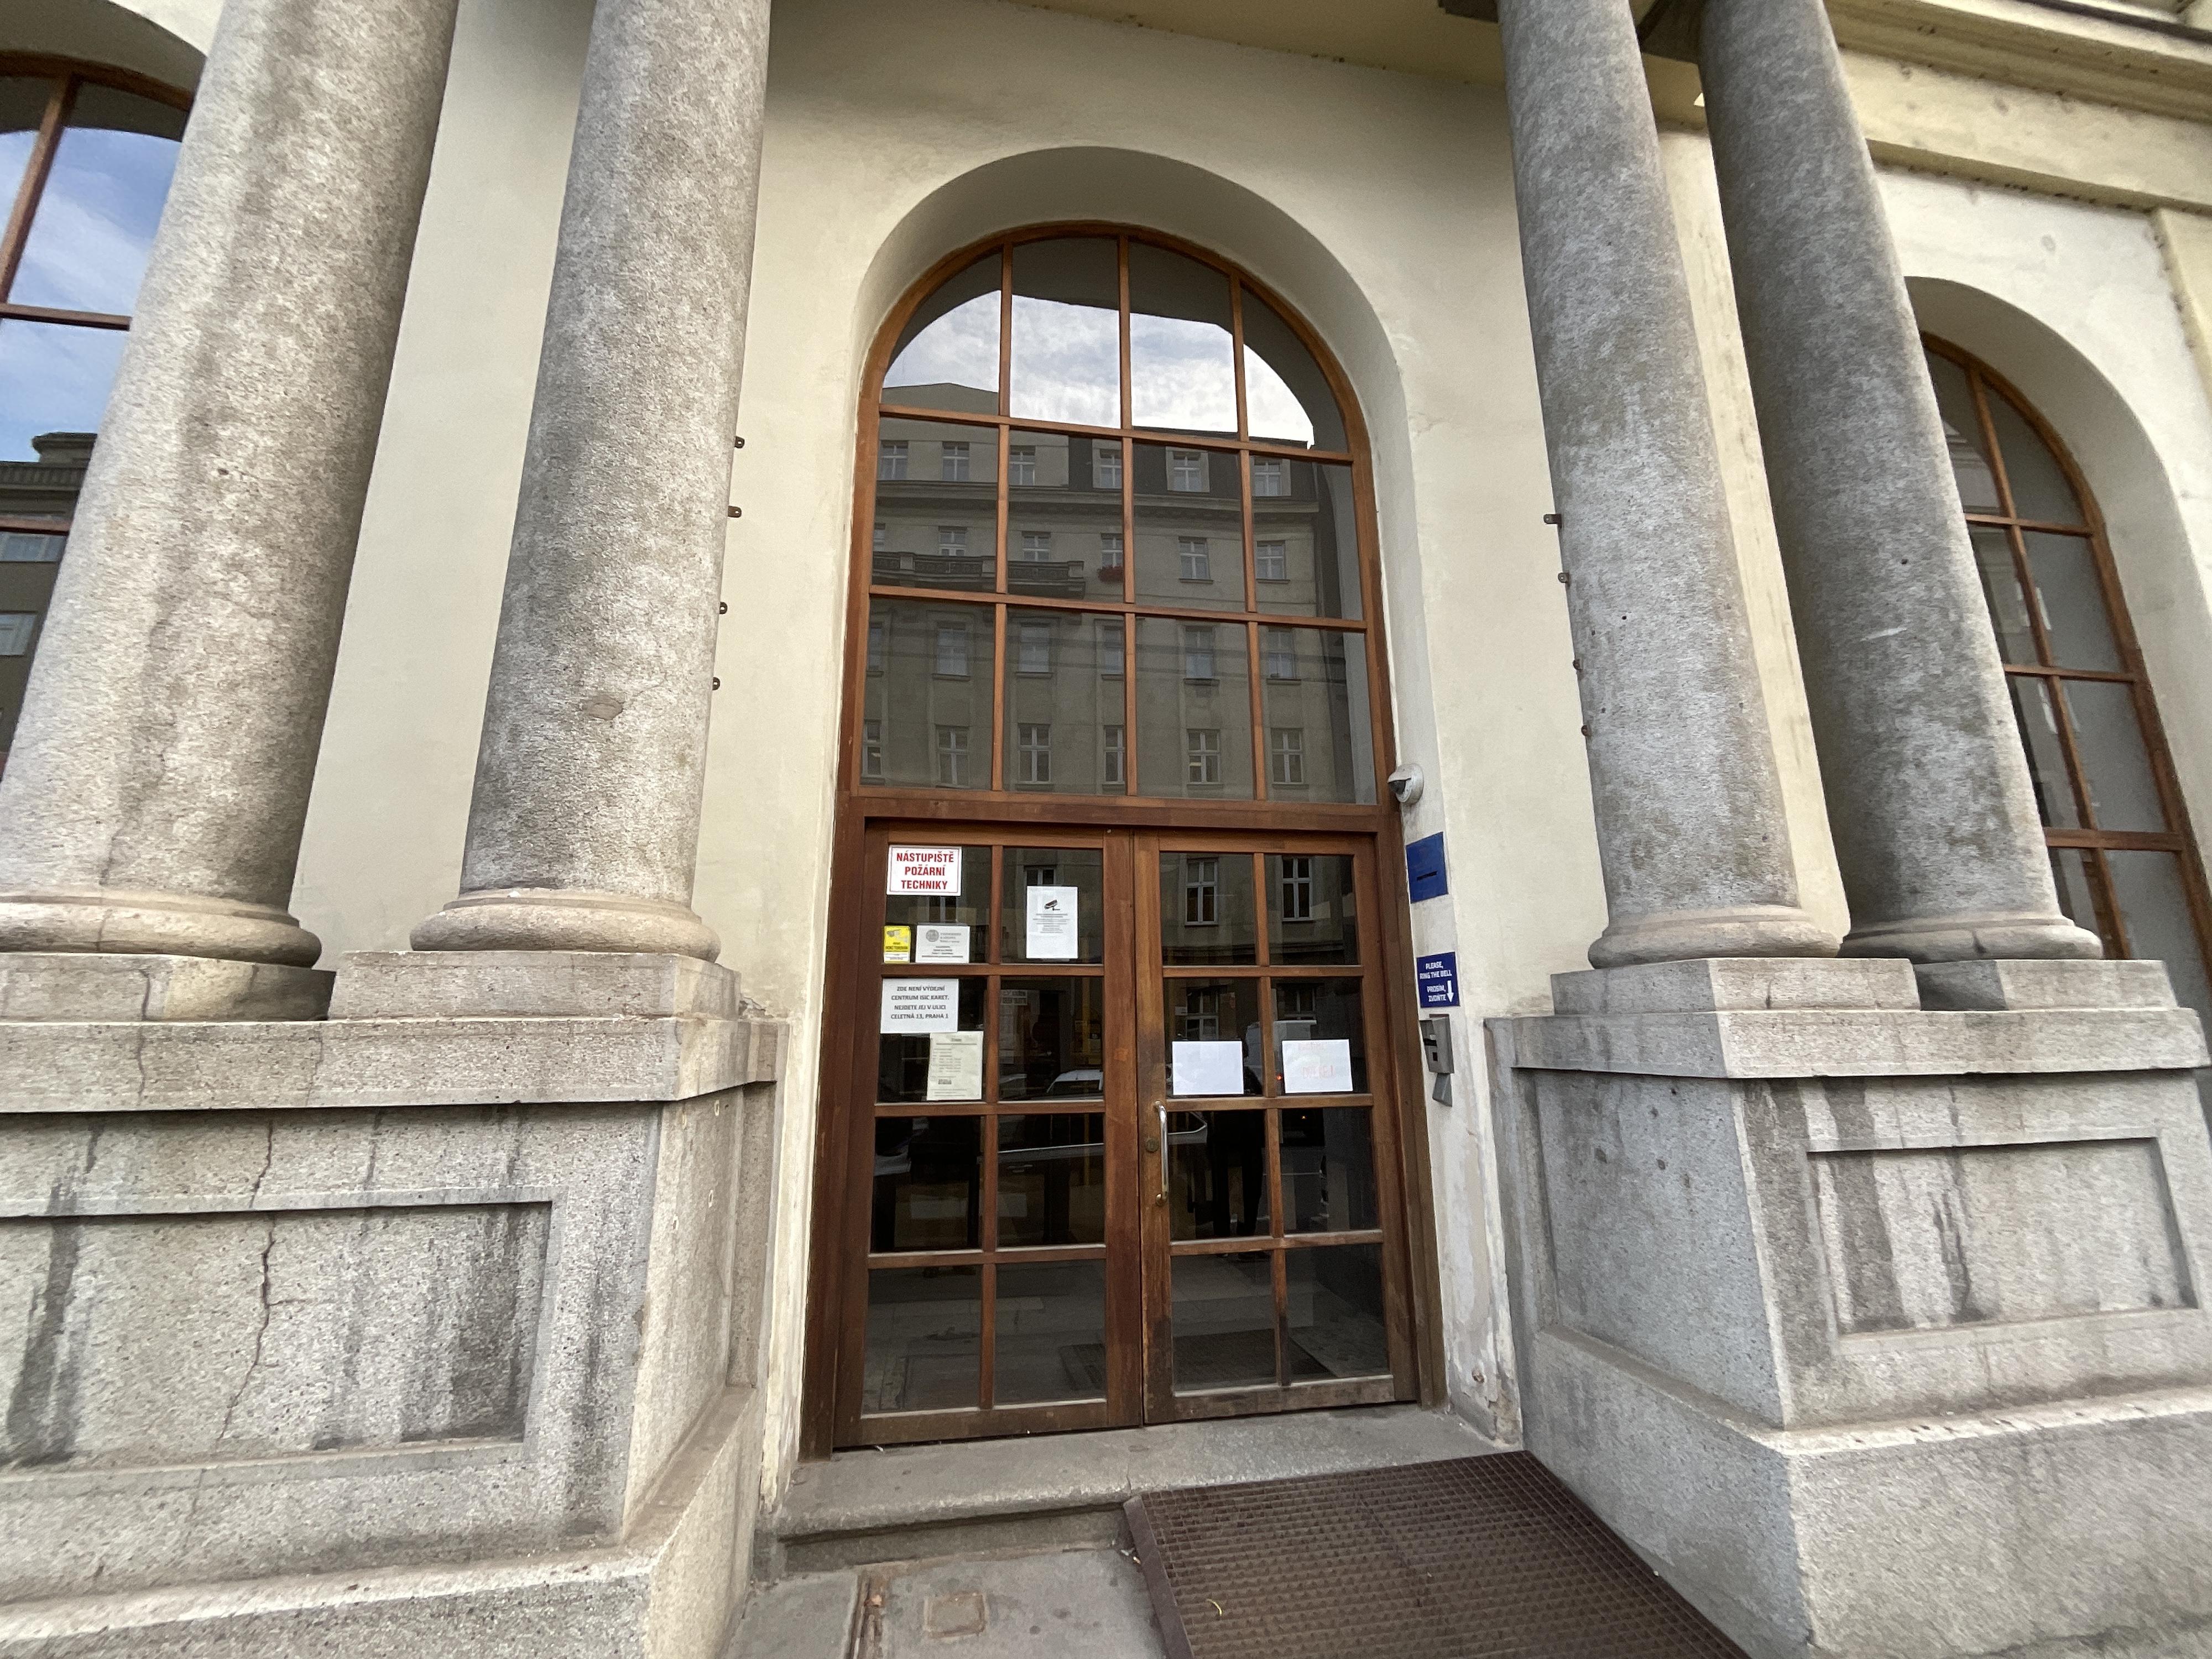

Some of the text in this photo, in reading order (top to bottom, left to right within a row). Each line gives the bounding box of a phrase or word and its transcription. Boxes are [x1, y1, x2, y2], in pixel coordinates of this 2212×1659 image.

[896, 850, 954, 862] NÁSTUPIŠTĚ
[904, 864, 946, 876] POŽÁRNÍ
[901, 880, 948, 890] TECHNIKY
[1425, 961, 1443, 969] PLEASE,
